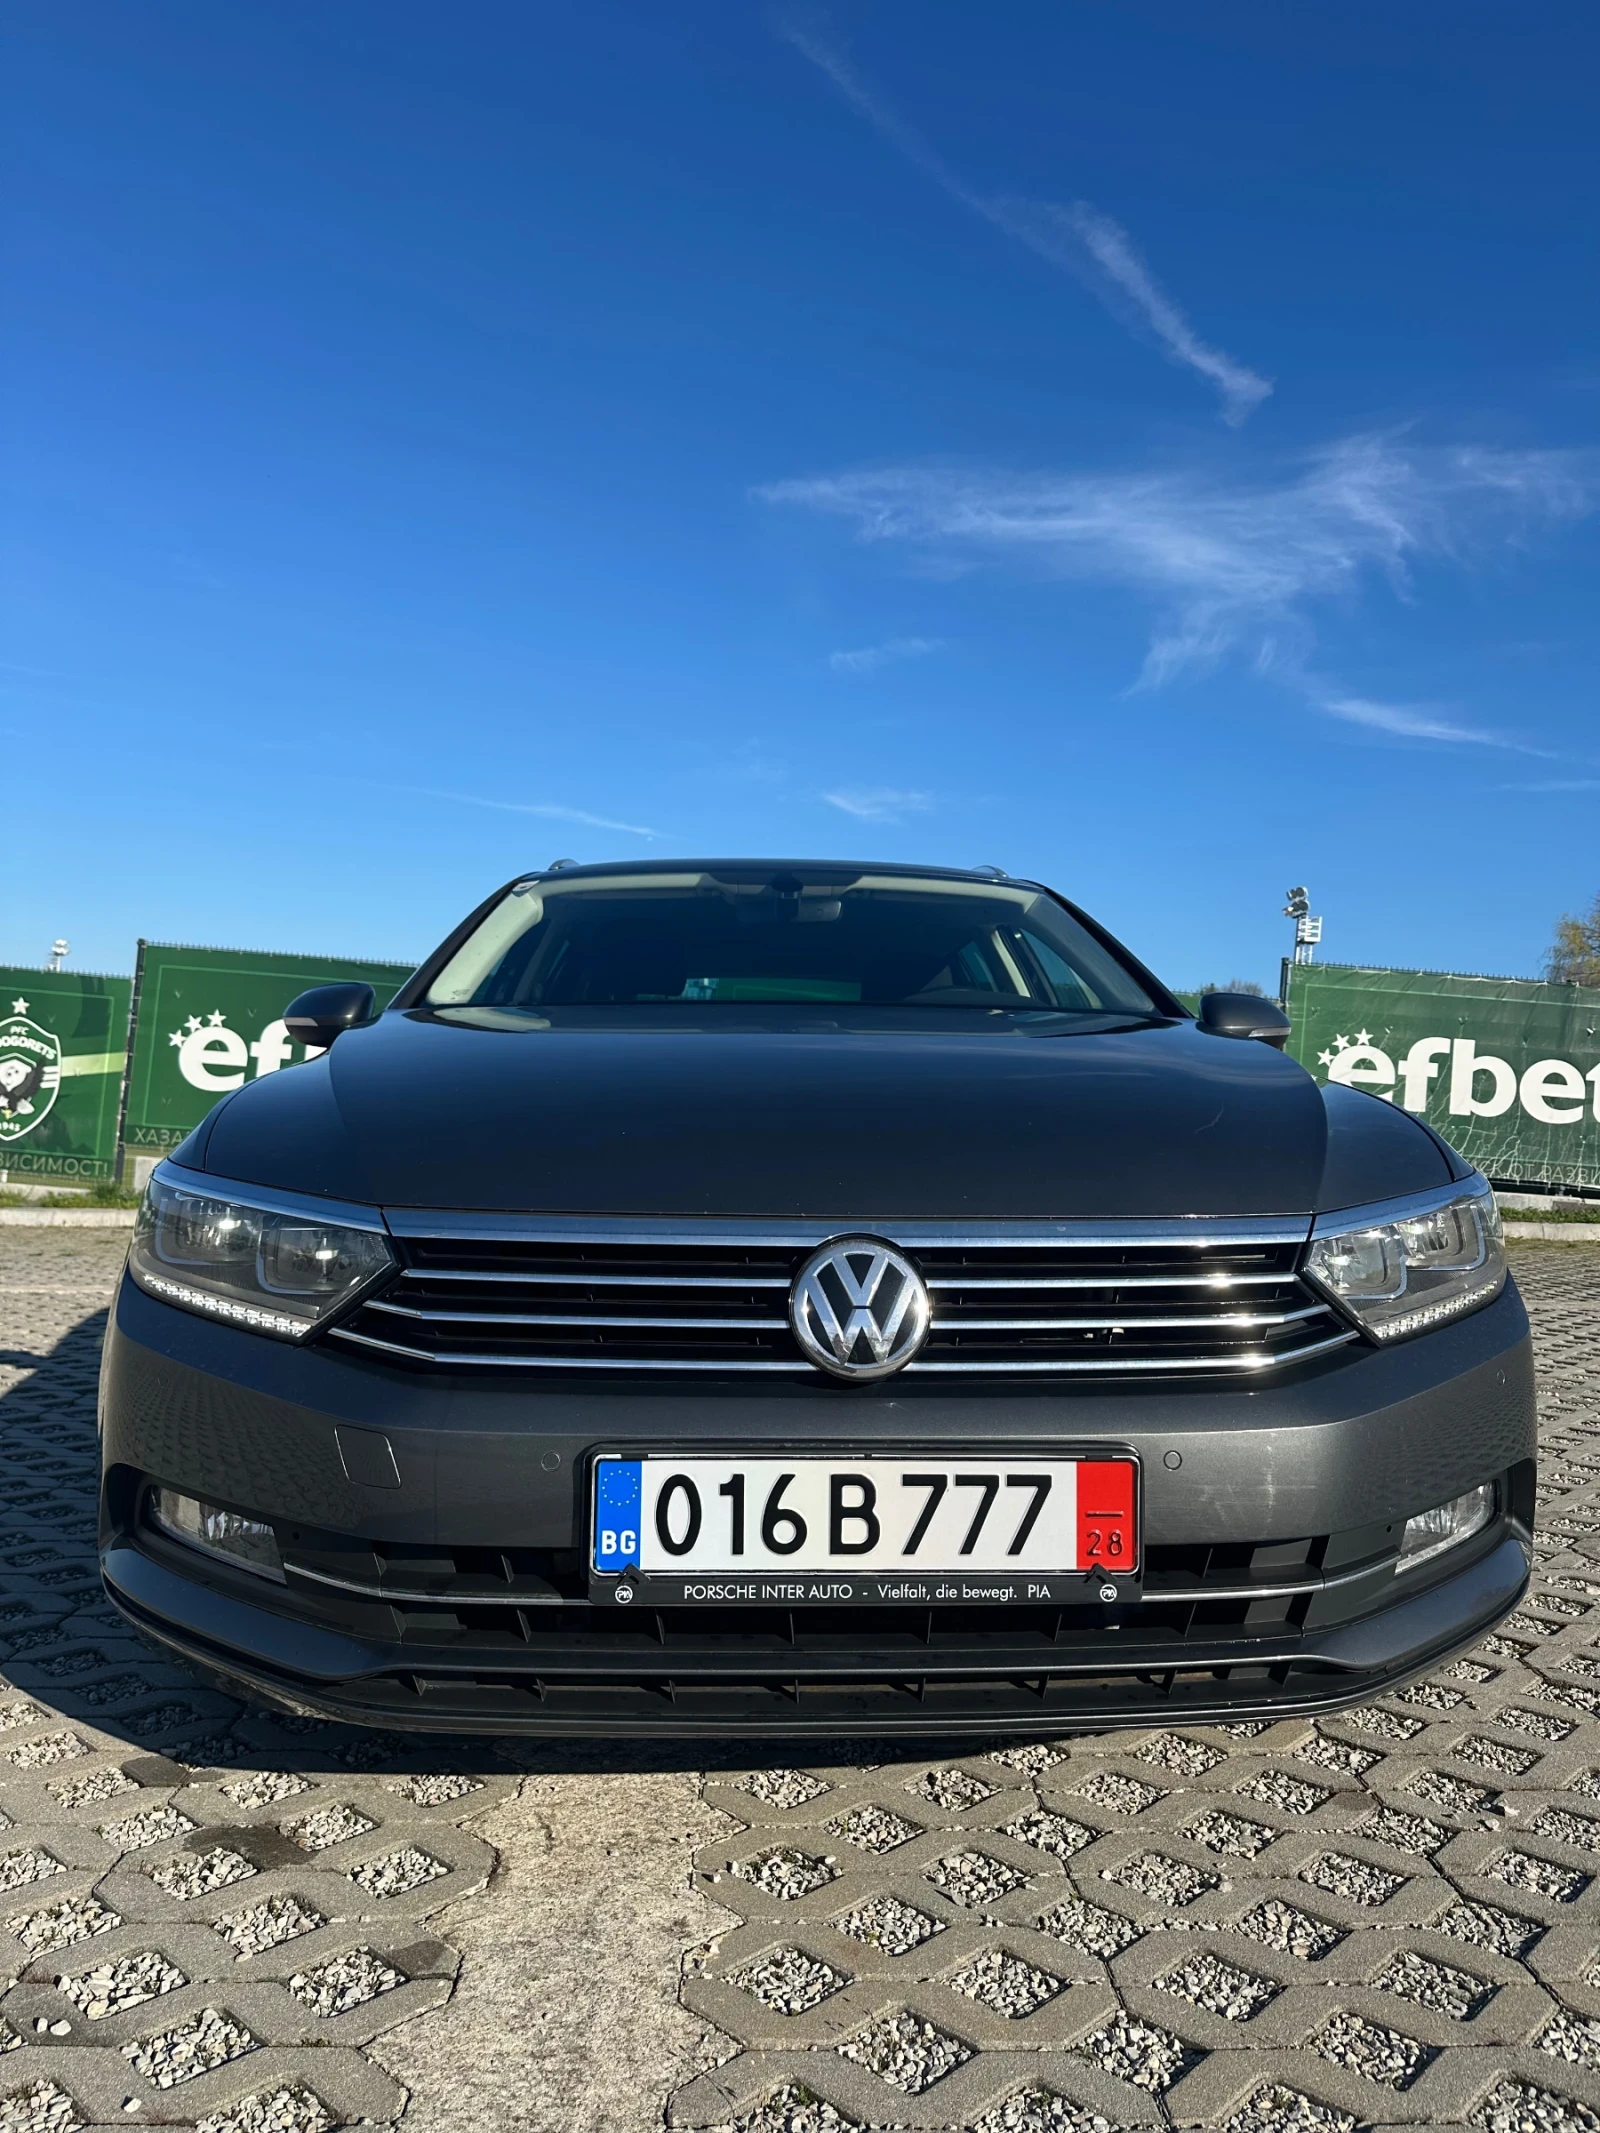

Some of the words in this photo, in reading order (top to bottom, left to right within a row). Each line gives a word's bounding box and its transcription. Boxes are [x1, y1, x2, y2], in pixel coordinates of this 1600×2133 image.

[0, 1035, 57, 1060] OGORETS
[178, 1018, 327, 1092] ef
[134, 1127, 191, 1145] ХАЗА
[655, 1473, 808, 1556] 016
[829, 1473, 881, 1556] B
[901, 1473, 1053, 1556] 777
[601, 1529, 637, 1555] BG
[1086, 1529, 1123, 1557] 28
[684, 1584, 757, 1600] PORSCHE
[762, 1584, 805, 1599] INTER
[808, 1584, 853, 1599] AUTO
[877, 1583, 931, 1601] Vielfalt,
[935, 1583, 958, 1599] die
[962, 1583, 1018, 1602] bewegt.
[1027, 1584, 1051, 1599] PIA
